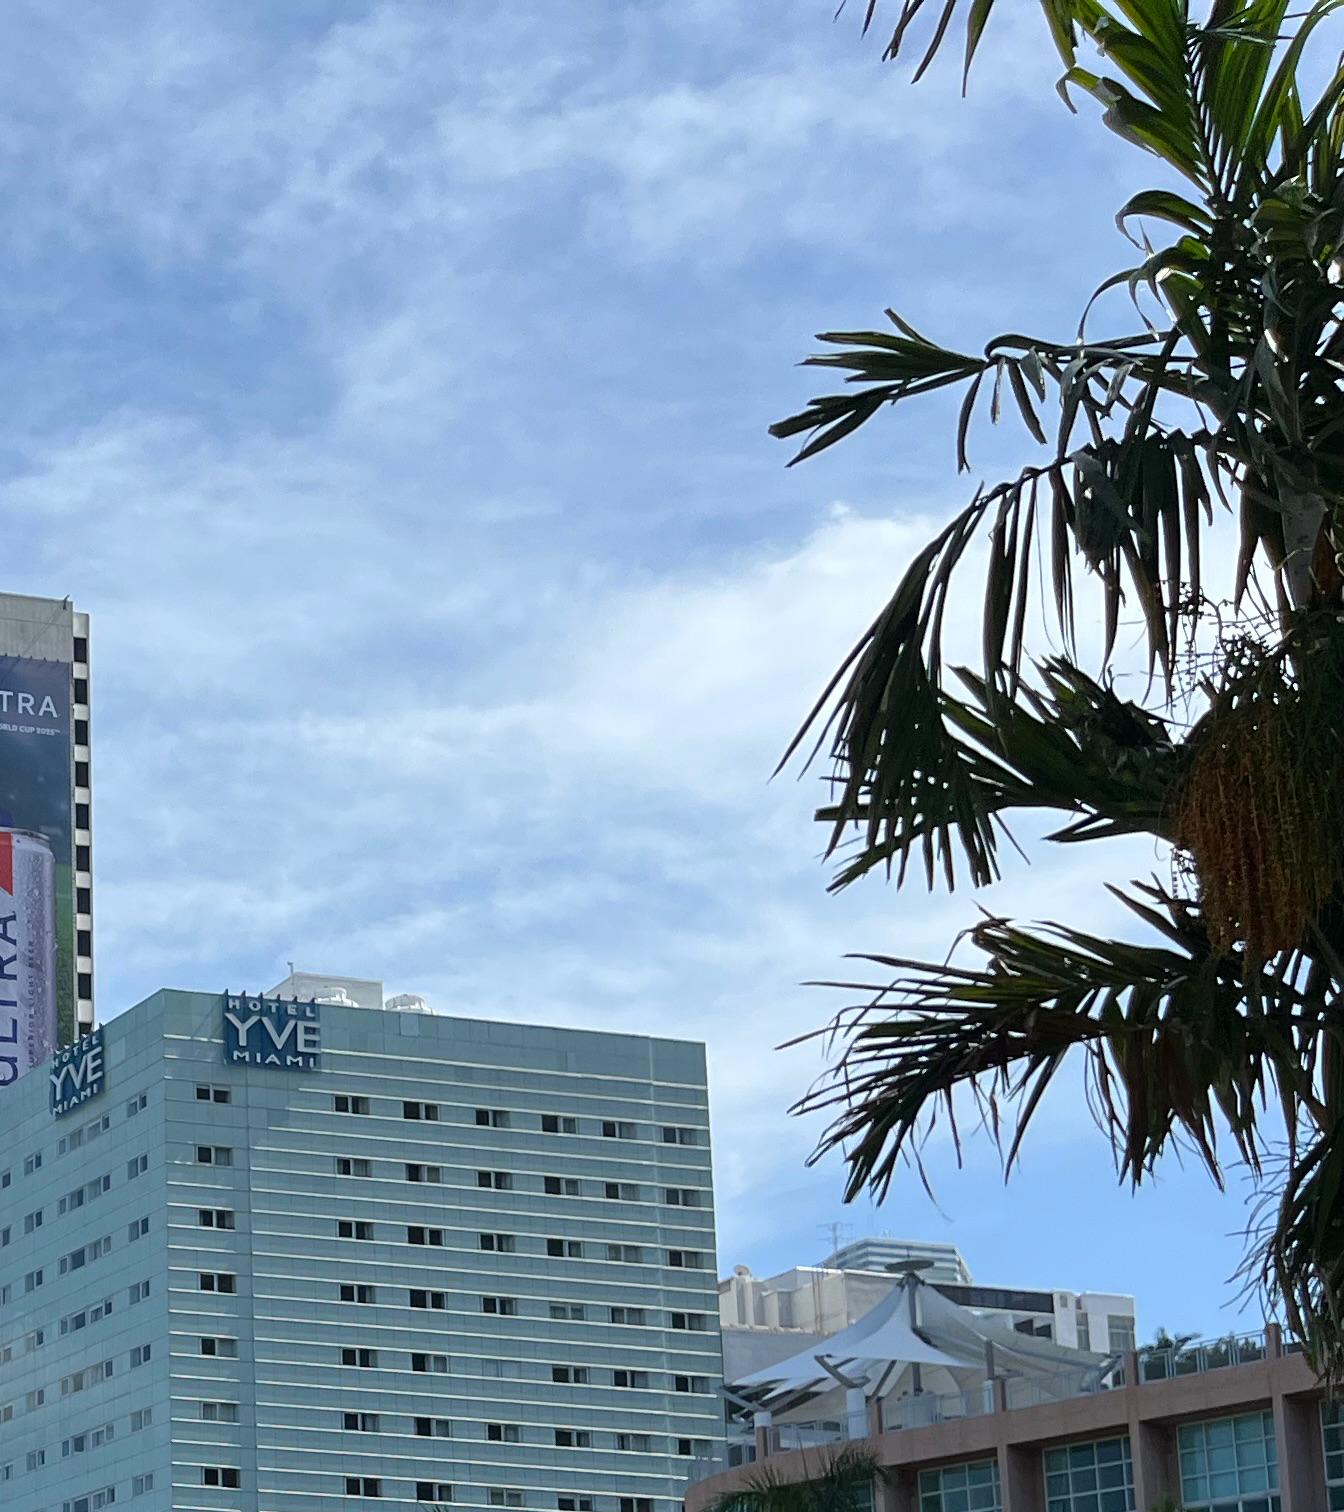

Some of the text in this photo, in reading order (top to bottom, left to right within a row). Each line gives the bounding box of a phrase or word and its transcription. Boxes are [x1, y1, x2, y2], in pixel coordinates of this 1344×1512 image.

[19, 725, 35, 734] CUP
[228, 998, 316, 1018] HOTEL
[224, 1012, 321, 1054] YVE
[52, 1035, 99, 1069] HOTEL
[232, 1050, 315, 1068] MIAMI
[50, 1046, 103, 1101] YVE
[52, 1083, 98, 1120] MIAMI
